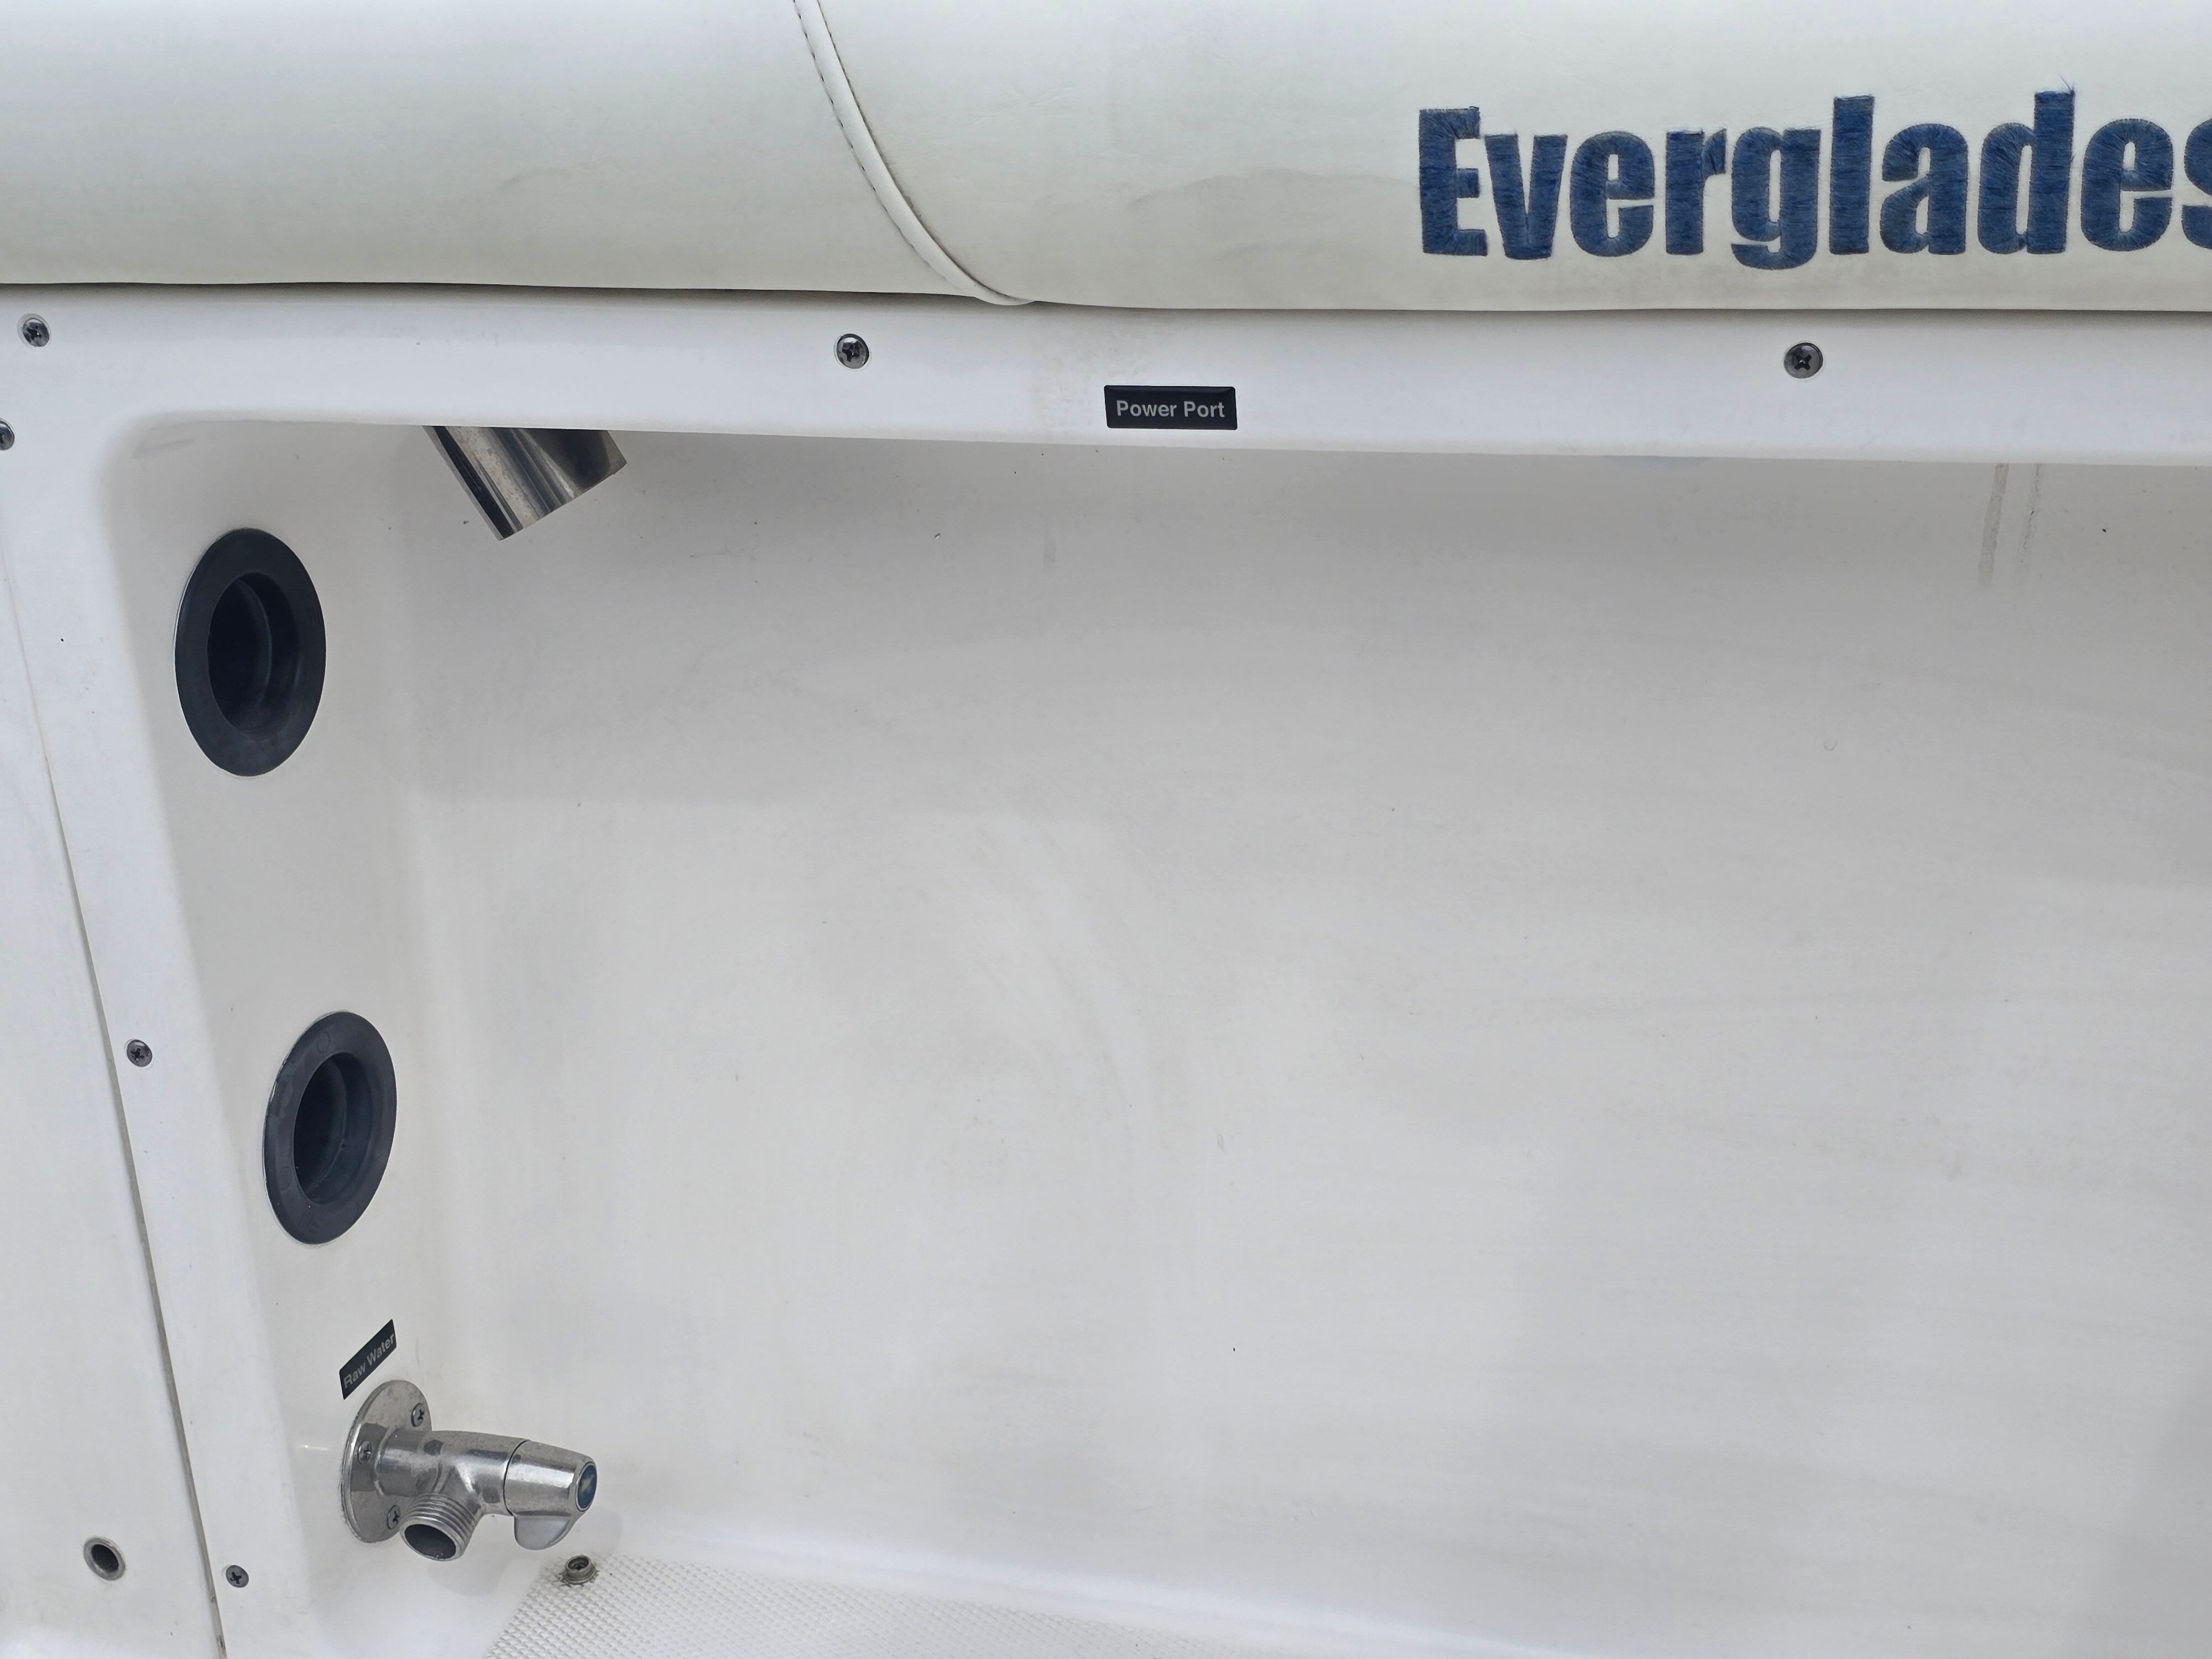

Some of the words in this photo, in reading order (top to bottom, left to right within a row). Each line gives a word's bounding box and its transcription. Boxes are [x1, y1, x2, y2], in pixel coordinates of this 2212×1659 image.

[1117, 400, 1177, 417] Power
[1183, 401, 1225, 418] Port
[343, 1362, 366, 1389] Raw
[367, 1333, 394, 1366] Water
